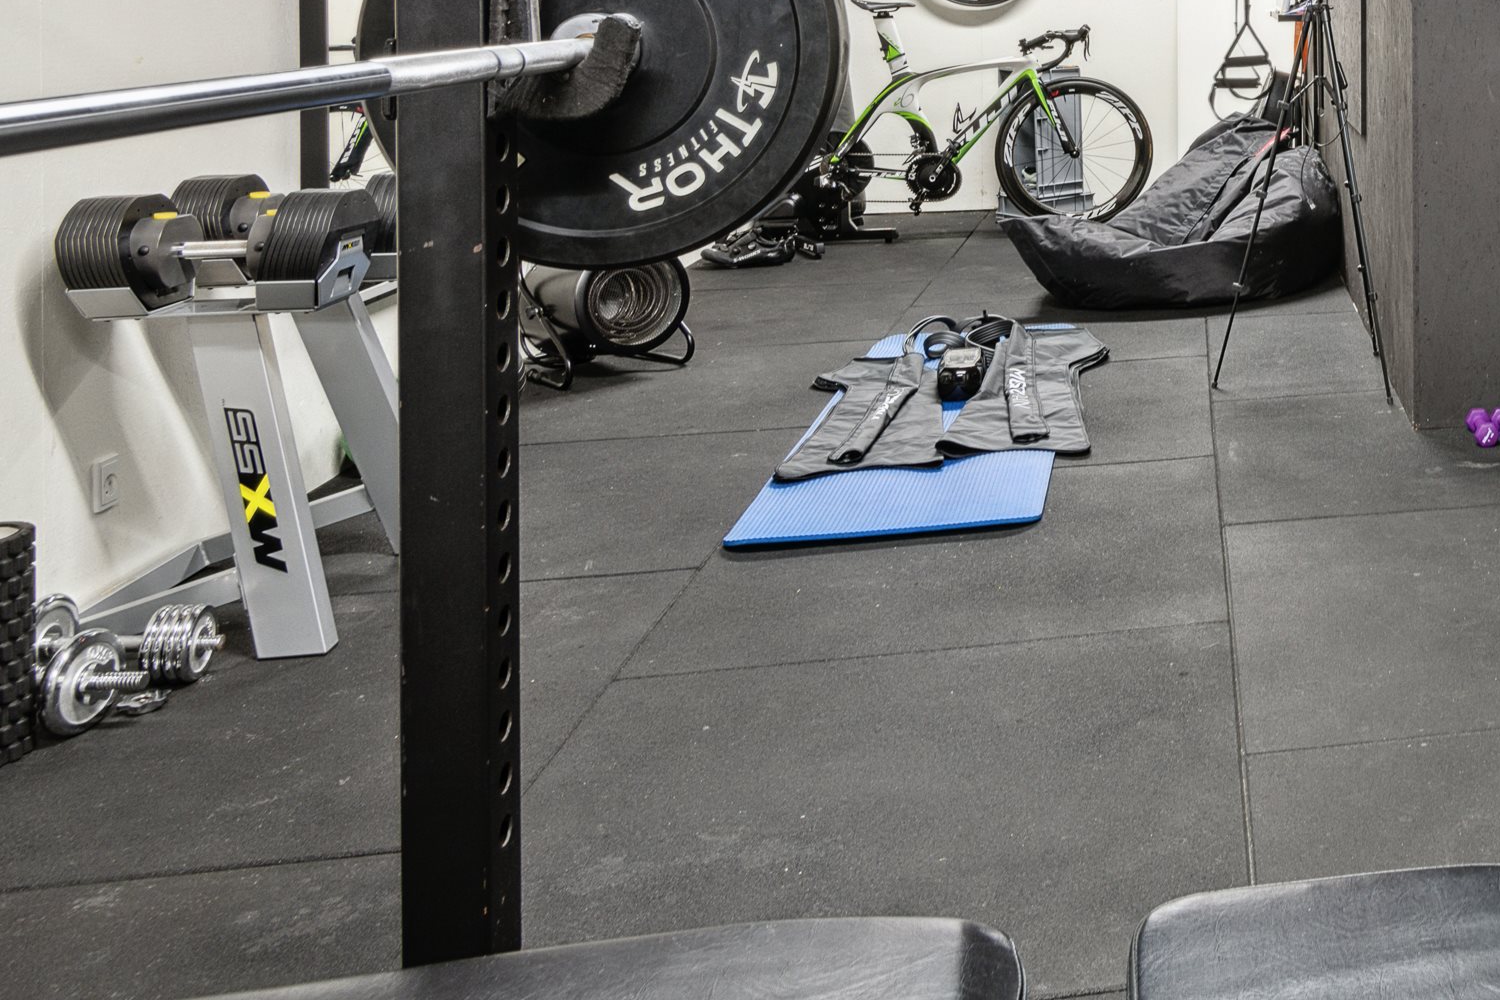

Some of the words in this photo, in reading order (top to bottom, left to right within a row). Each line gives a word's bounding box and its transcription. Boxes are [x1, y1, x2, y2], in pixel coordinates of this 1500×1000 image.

[639, 119, 719, 177] FITNESS
[1003, 102, 1032, 168] ZIPP
[1095, 90, 1143, 140] ZIPP
[609, 107, 763, 212] THOR
[223, 407, 288, 574] MX55
